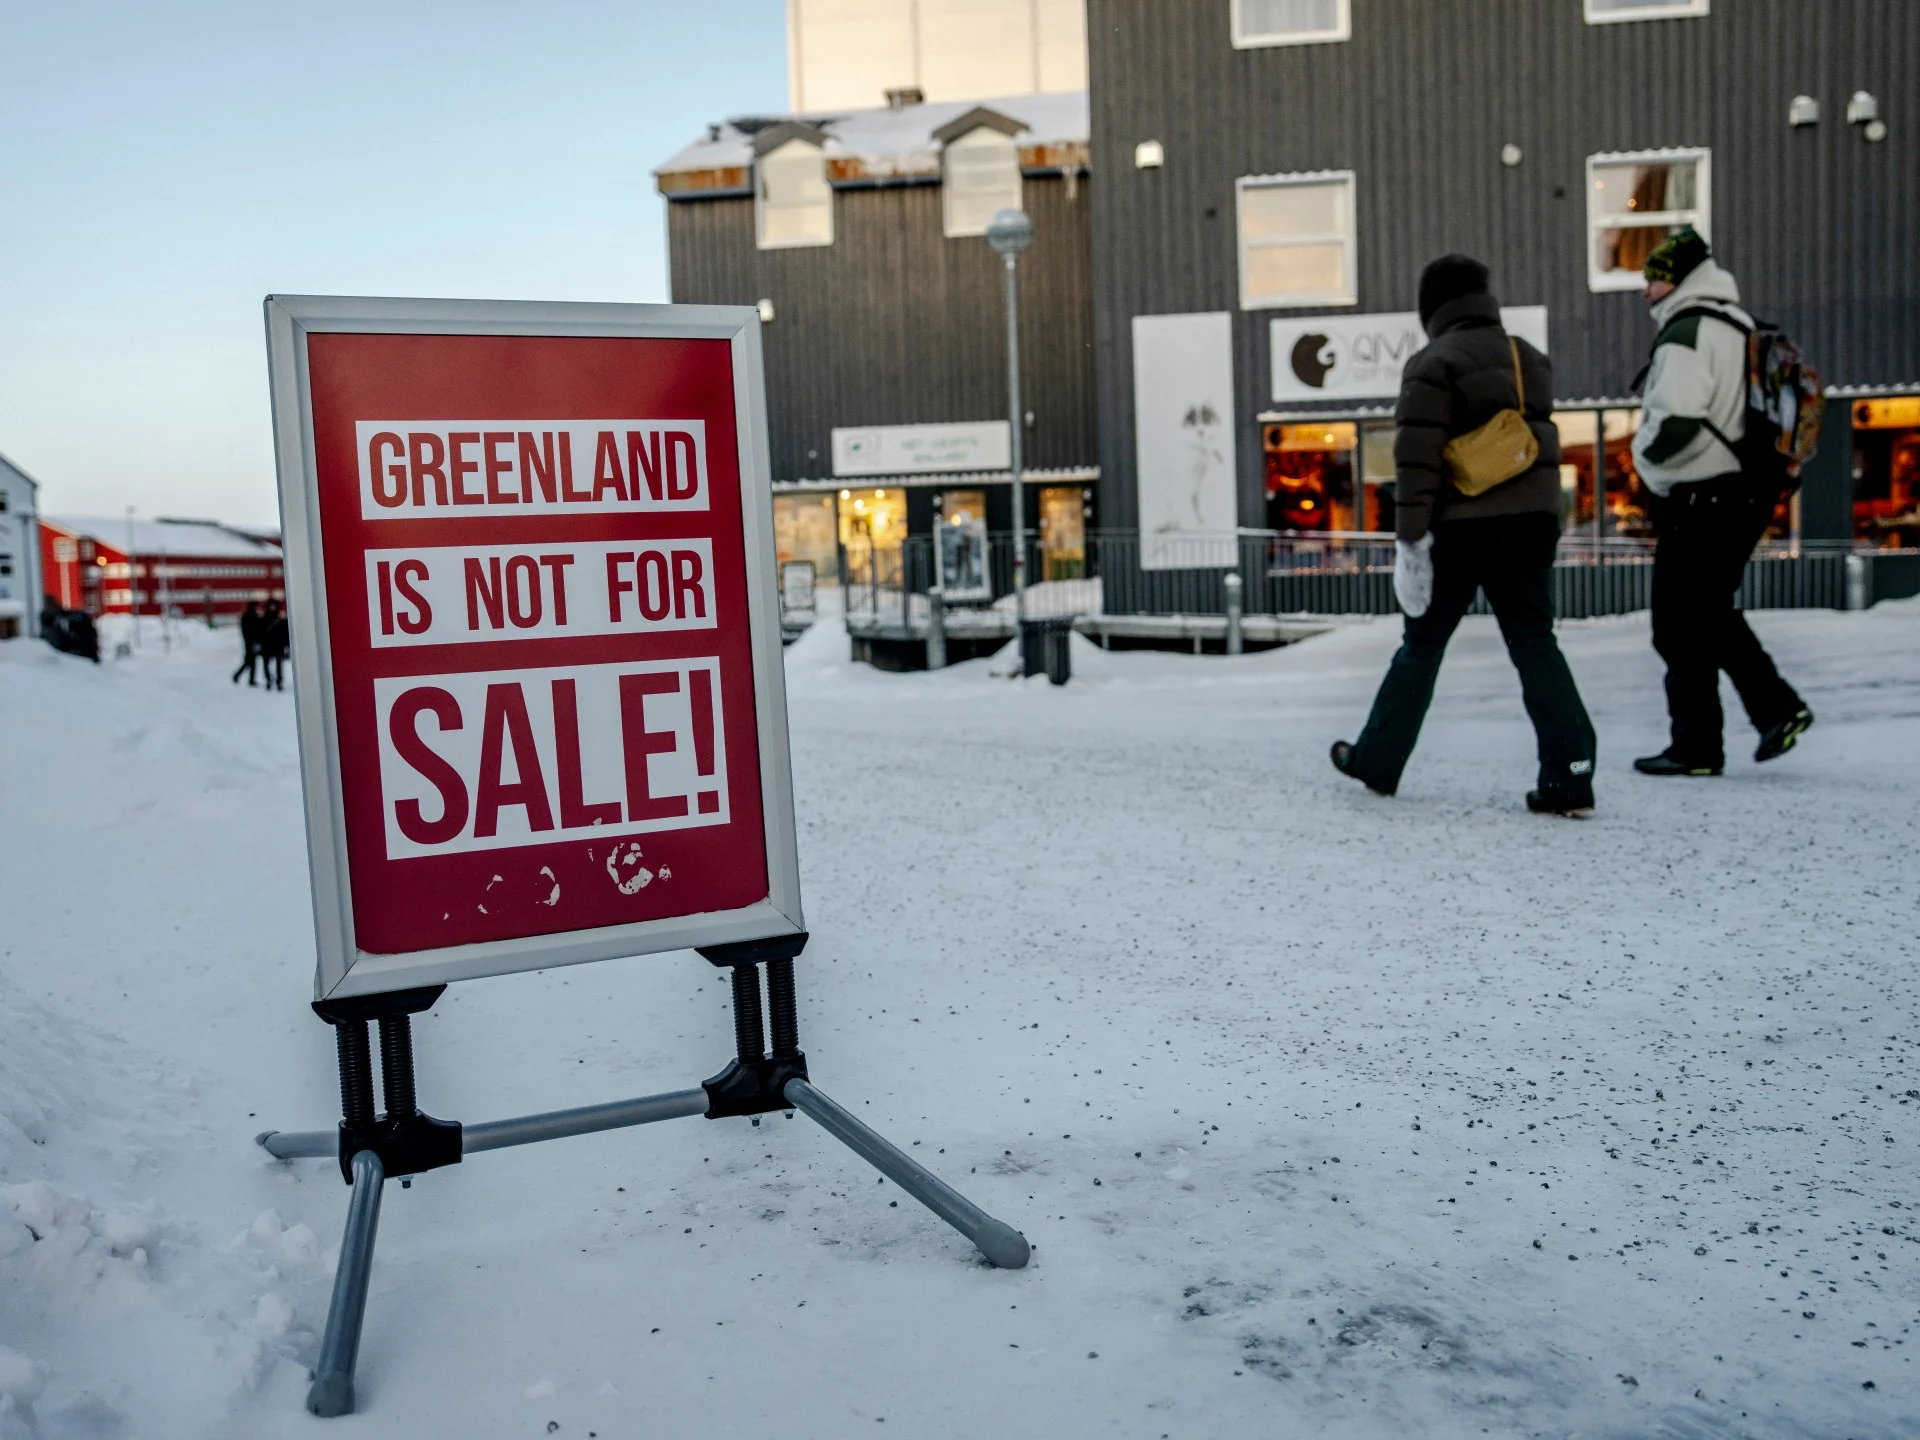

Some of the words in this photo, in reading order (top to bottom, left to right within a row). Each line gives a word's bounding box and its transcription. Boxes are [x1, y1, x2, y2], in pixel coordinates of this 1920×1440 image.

[1352, 331, 1419, 363] QIVI
[369, 431, 698, 508] GREENLAND
[377, 559, 433, 636] IS
[464, 553, 575, 631] NOT
[606, 549, 706, 623] FOR
[389, 668, 720, 845] SALE!
